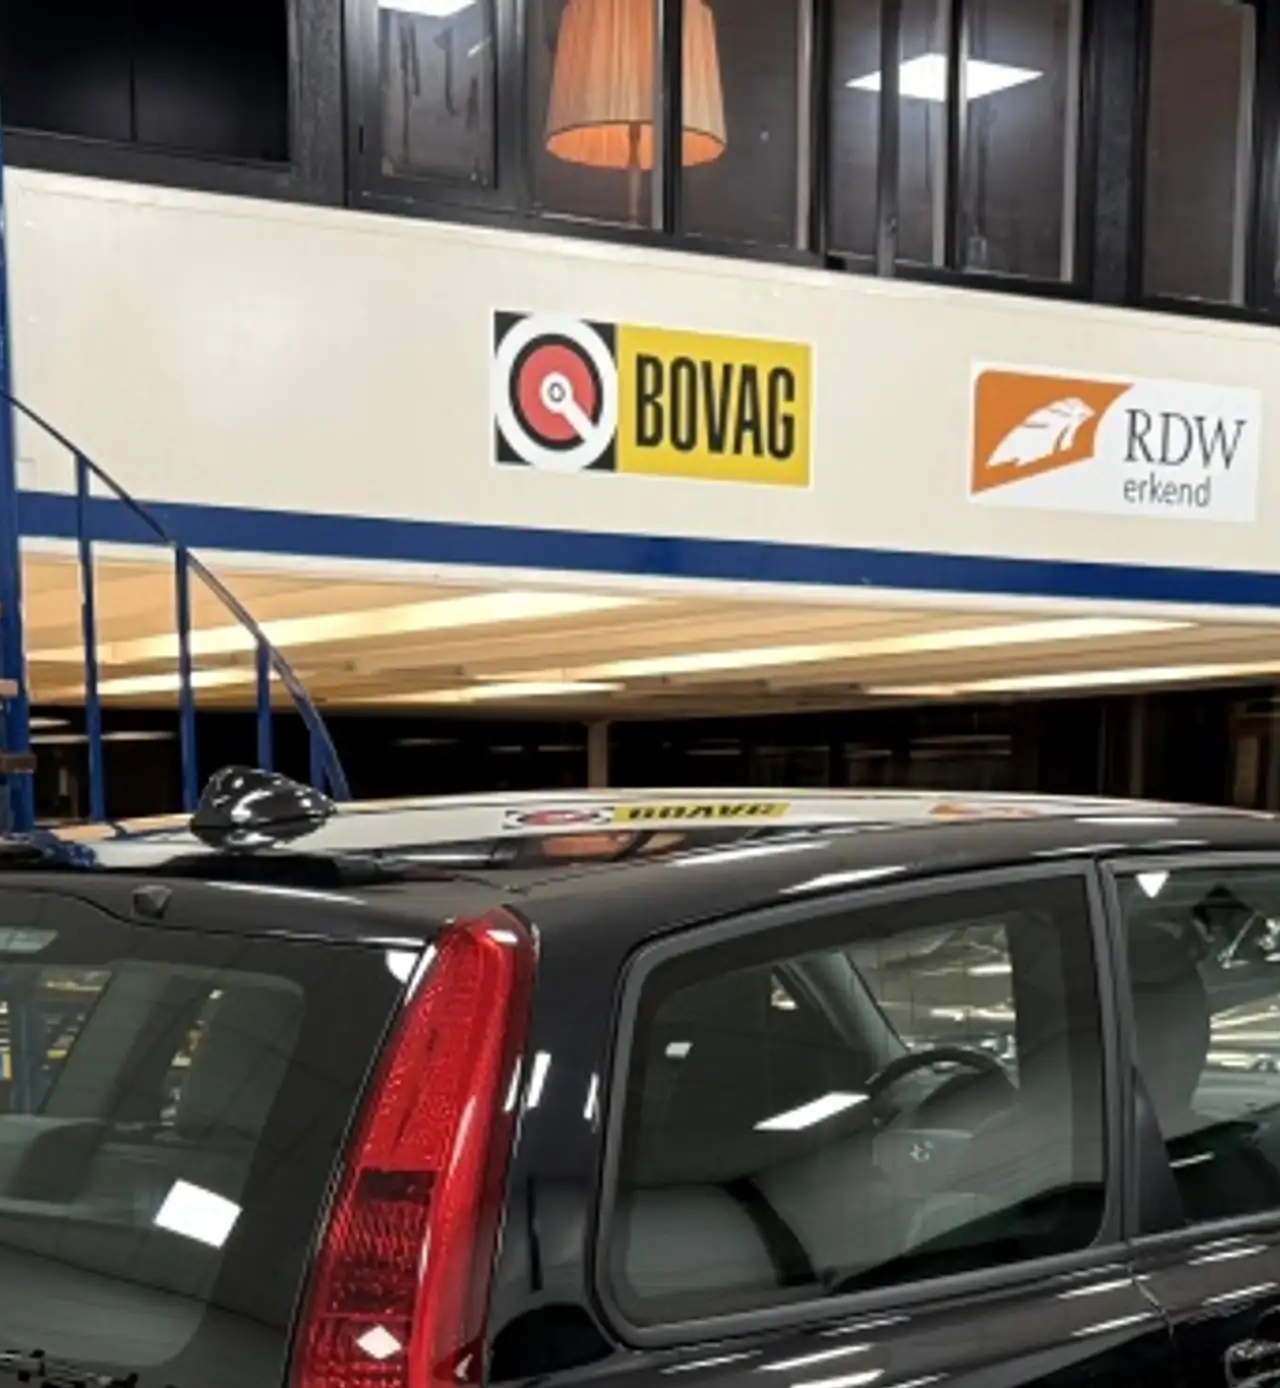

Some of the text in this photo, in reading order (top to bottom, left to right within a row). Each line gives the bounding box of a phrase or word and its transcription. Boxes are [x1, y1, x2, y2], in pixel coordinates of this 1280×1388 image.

[635, 352, 796, 462] BOVAG
[1123, 408, 1247, 470] RDW
[1123, 471, 1212, 508] erkend
